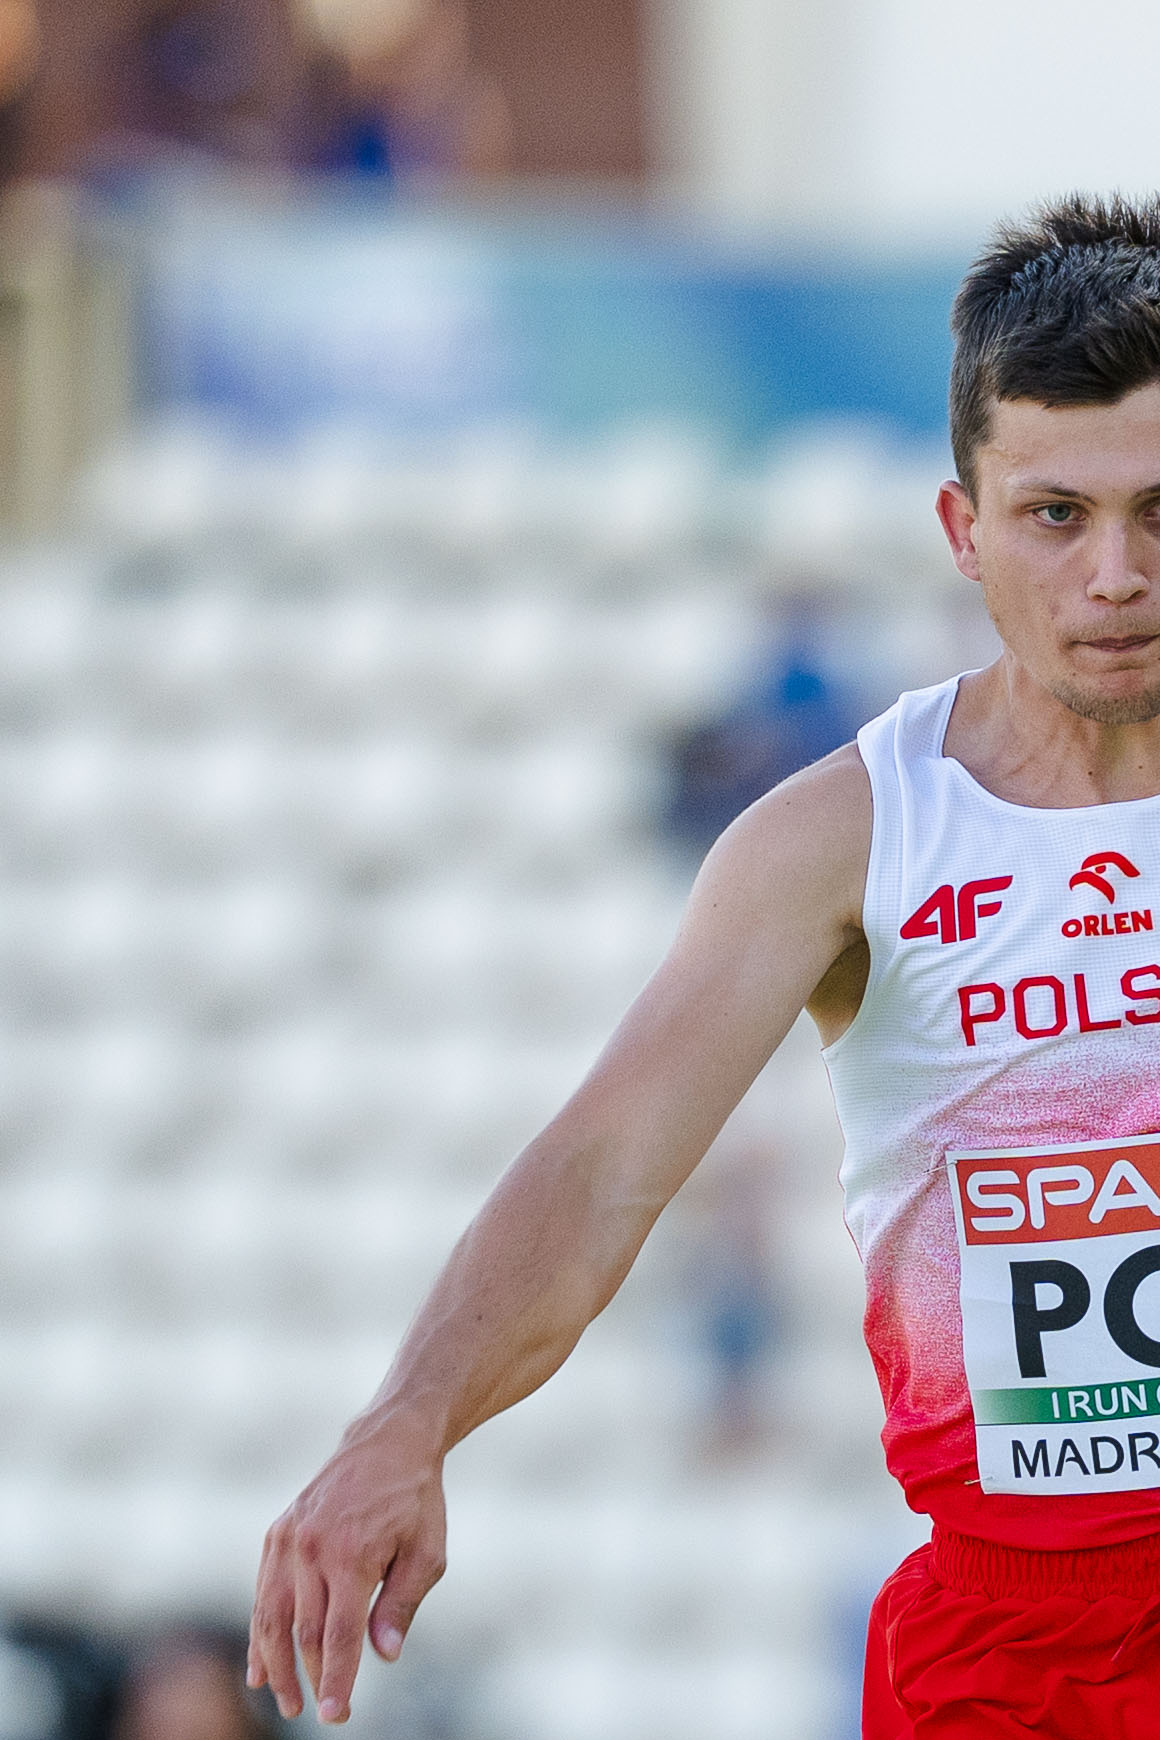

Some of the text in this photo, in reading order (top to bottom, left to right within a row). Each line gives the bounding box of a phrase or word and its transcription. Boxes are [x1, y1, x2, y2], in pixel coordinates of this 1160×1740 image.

[900, 875, 1013, 944] 4F
[1061, 909, 1154, 938] ORLEN
[1052, 1391, 1060, 1419] I
[1068, 1383, 1148, 1419] RUN
